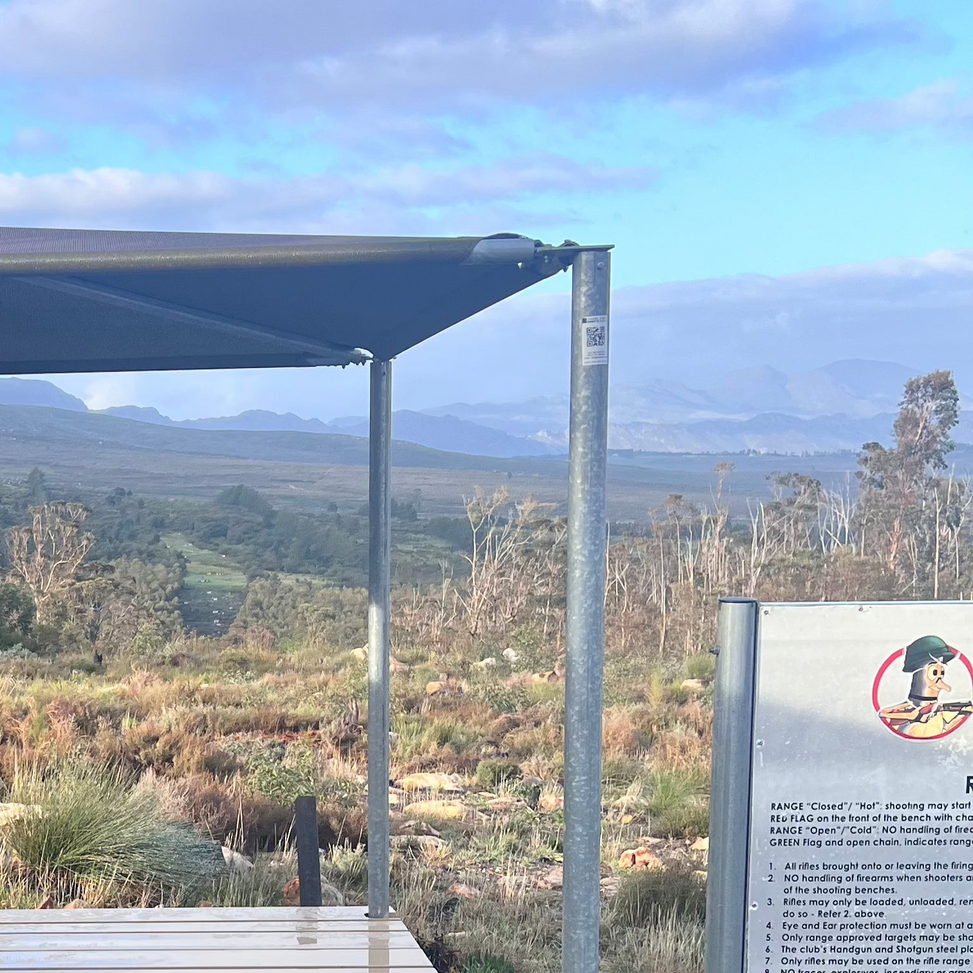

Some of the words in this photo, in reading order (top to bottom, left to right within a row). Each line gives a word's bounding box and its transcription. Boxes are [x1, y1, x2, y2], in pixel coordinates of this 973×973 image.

[771, 802, 804, 810] RANGE
[885, 802, 925, 813] shooting
[927, 804, 949, 813] may
[951, 802, 971, 810] start
[791, 814, 814, 822] FLAG
[831, 814, 846, 822] the
[849, 814, 870, 822] front
[883, 814, 898, 822] the
[901, 814, 931, 822] bench
[934, 814, 953, 822] with
[770, 826, 803, 834] RANGE
[882, 826, 897, 834] NO
[900, 826, 941, 837] handling
[769, 838, 800, 846] GREEN
[803, 838, 822, 849] Flag
[825, 838, 843, 846] and
[846, 840, 870, 849] open
[905, 838, 947, 846] indicates
[785, 862, 797, 870] All
[799, 862, 820, 870] rifles
[823, 862, 859, 873] brought
[861, 862, 882, 870] onto
[896, 862, 931, 873] leaving
[934, 862, 949, 870] the
[784, 874, 799, 882] NO
[802, 874, 843, 885] handling
[857, 874, 894, 882] firearms
[896, 874, 922, 882] when
[924, 874, 963, 882] shooters
[795, 886, 810, 894] the
[813, 886, 852, 897] shooting
[783, 898, 806, 906] Rifles
[809, 900, 830, 908] may
[833, 898, 852, 908] only
[818, 910, 841, 918] Refer
[783, 922, 799, 932] Eye
[801, 922, 820, 930] and
[823, 922, 837, 930] Ear
[839, 922, 887, 932] protection
[889, 922, 912, 930] must
[915, 922, 927, 930] be
[781, 933, 803, 944] Only
[805, 935, 833, 944] range
[836, 933, 882, 944] approved
[885, 933, 916, 944] targets
[919, 935, 940, 944] may
[781, 945, 797, 954] The
[799, 945, 827, 954] club's
[830, 945, 872, 956] Handgun
[875, 945, 893, 954] and
[896, 945, 934, 956] Shotgun
[936, 945, 958, 954] steel
[781, 957, 803, 968] Only
[805, 957, 825, 965] rifles
[828, 959, 849, 968] may
[851, 957, 864, 965] be
[867, 957, 889, 965] used
[906, 957, 921, 965] the
[923, 957, 940, 965] rifle
[942, 959, 970, 968] range
